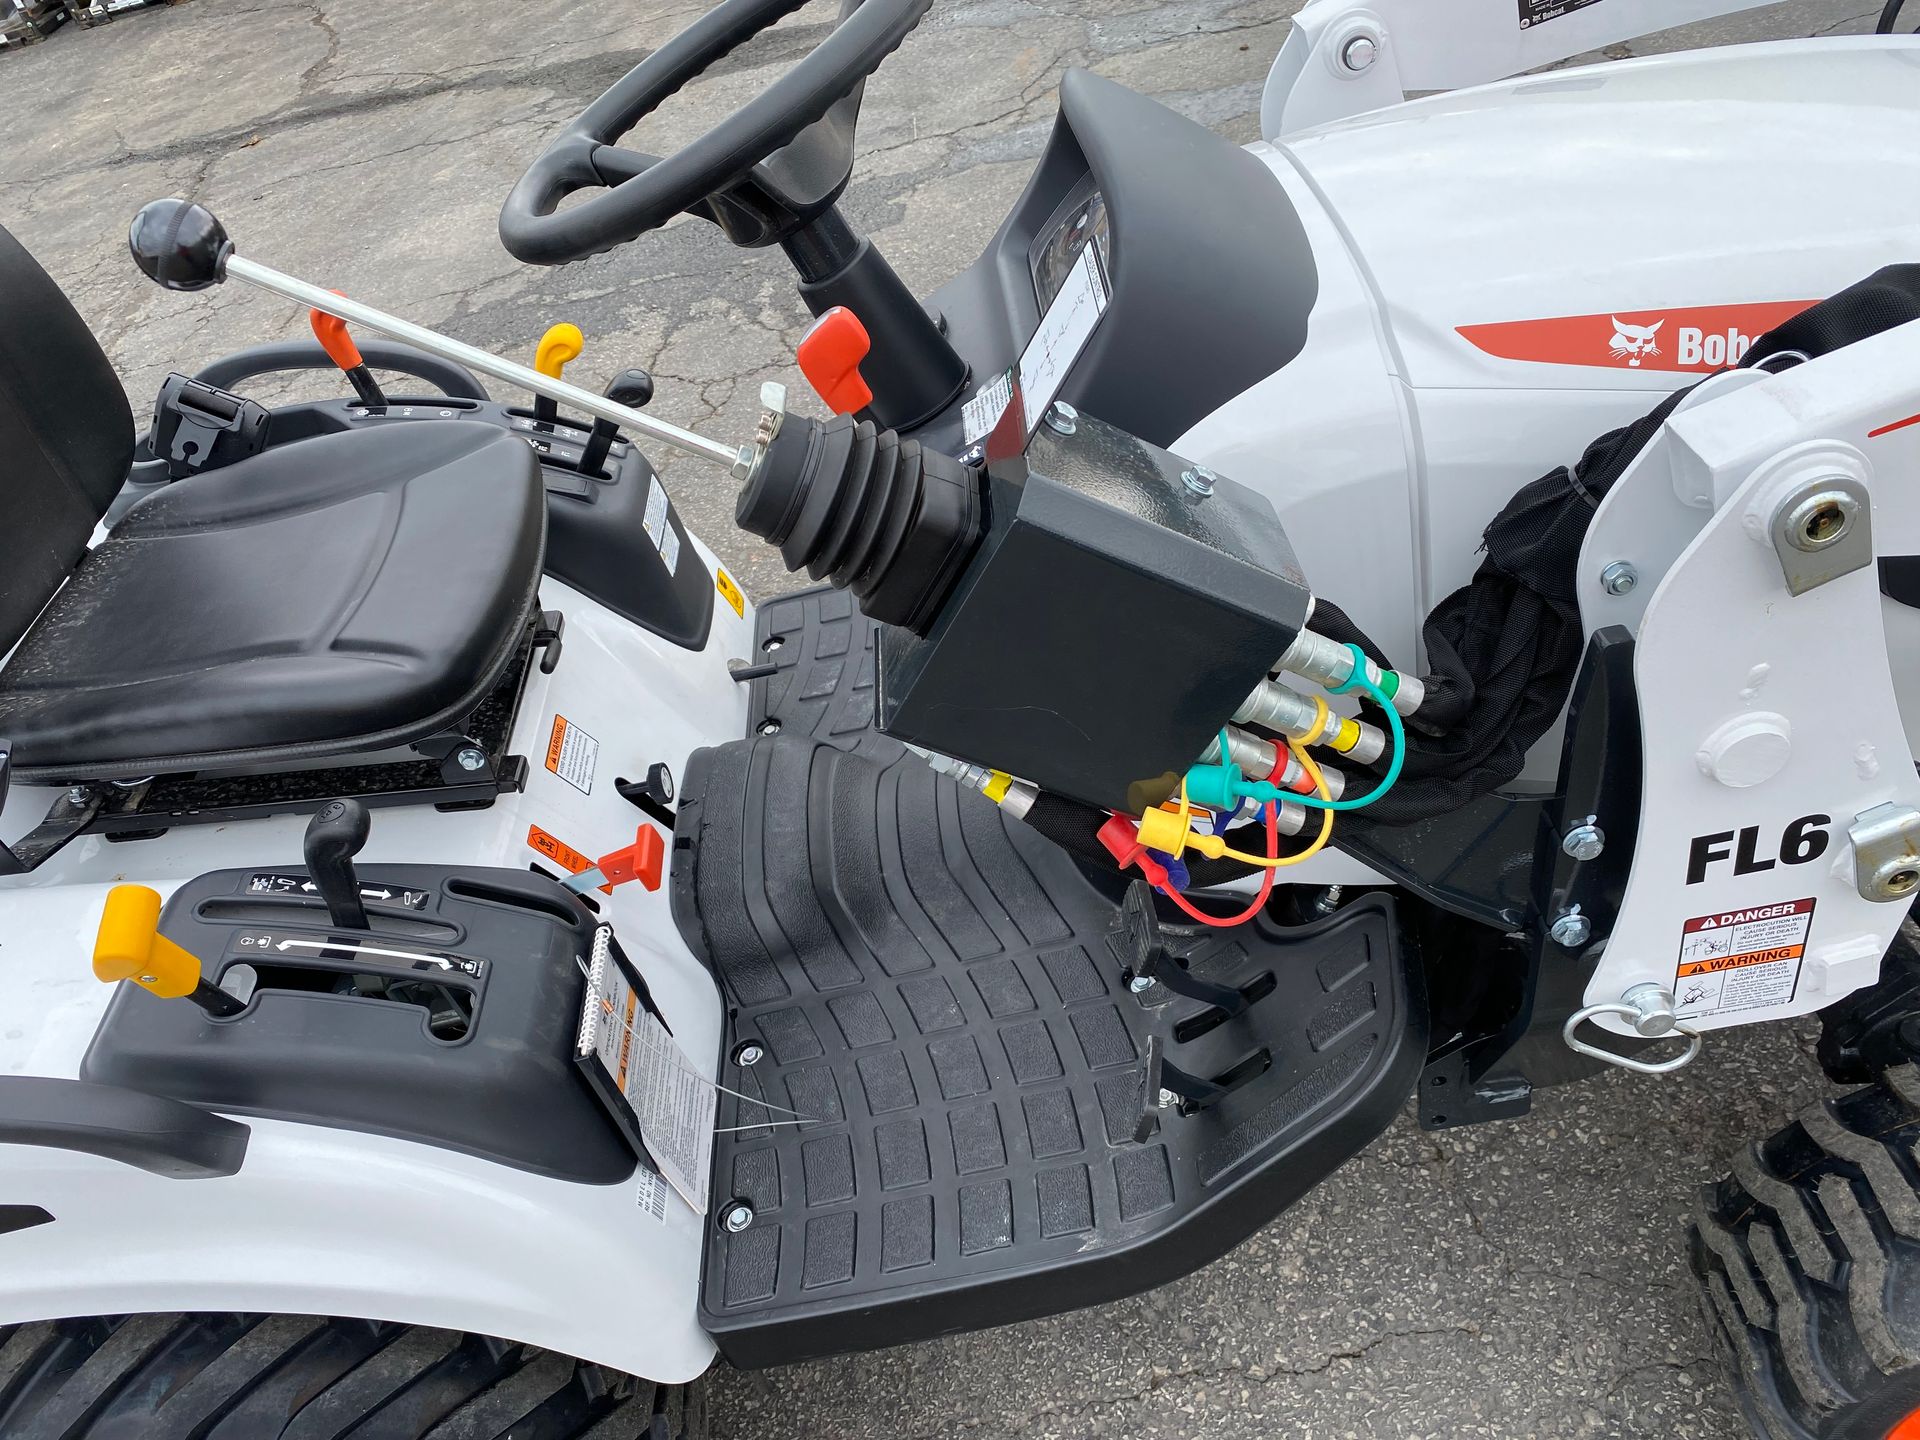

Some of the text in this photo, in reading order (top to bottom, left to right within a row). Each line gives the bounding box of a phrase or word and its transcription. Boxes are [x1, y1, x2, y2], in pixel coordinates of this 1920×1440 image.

[1542, 6, 1565, 20] Bobcat
[1677, 327, 1762, 366] Bob
[551, 723, 564, 756] WARNING
[1685, 813, 1832, 885] FL6
[1720, 903, 1796, 926] DANGER
[1735, 918, 1791, 932] ELECTROCUTION
[1740, 932, 1764, 940] INJURY
[1776, 926, 1799, 934] DEATH
[1744, 922, 1797, 935] CAUSE SERIOUS
[1710, 948, 1791, 970] WARNING
[1736, 963, 1772, 973] ROLLOVER
[1730, 975, 1754, 983] INJURY
[1767, 969, 1790, 977] DEATH
[1735, 965, 1788, 978] CAUSE SERIOUS
[622, 1009, 634, 1062] WARNNG
[637, 1182, 646, 1208] MODEL
